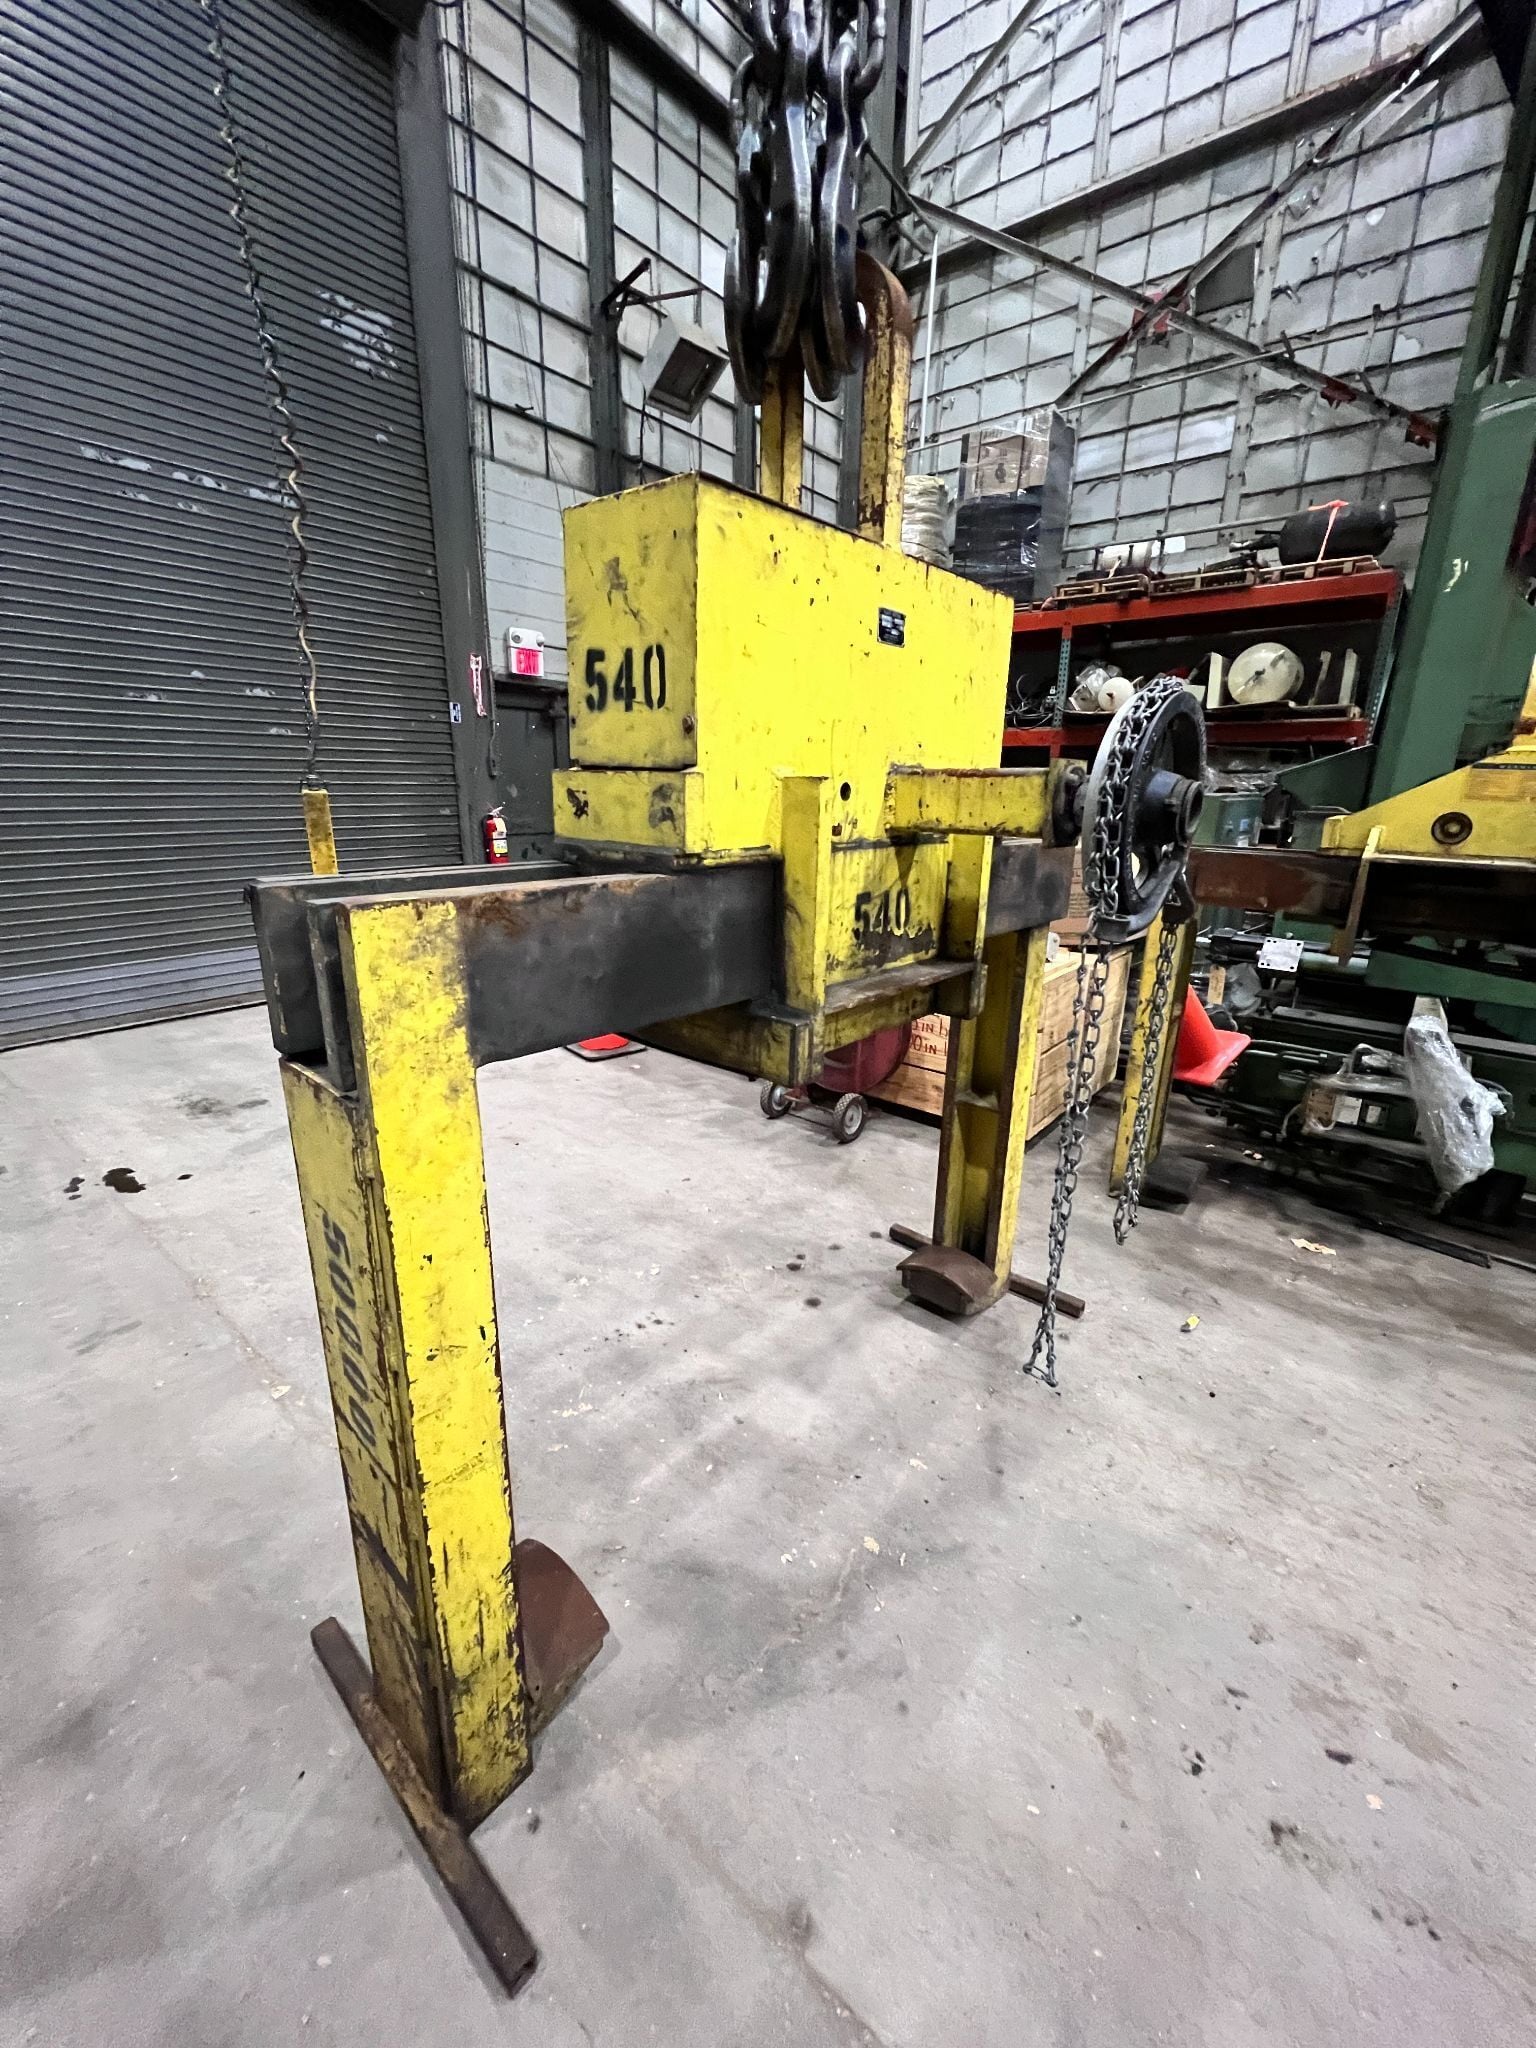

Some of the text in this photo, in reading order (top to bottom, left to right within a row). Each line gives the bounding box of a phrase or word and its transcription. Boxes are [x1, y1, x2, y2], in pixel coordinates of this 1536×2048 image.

[516, 648, 540, 675] EXIT
[585, 643, 667, 713] 540
[853, 887, 912, 942] 540
[322, 1212, 377, 1448] 50000
